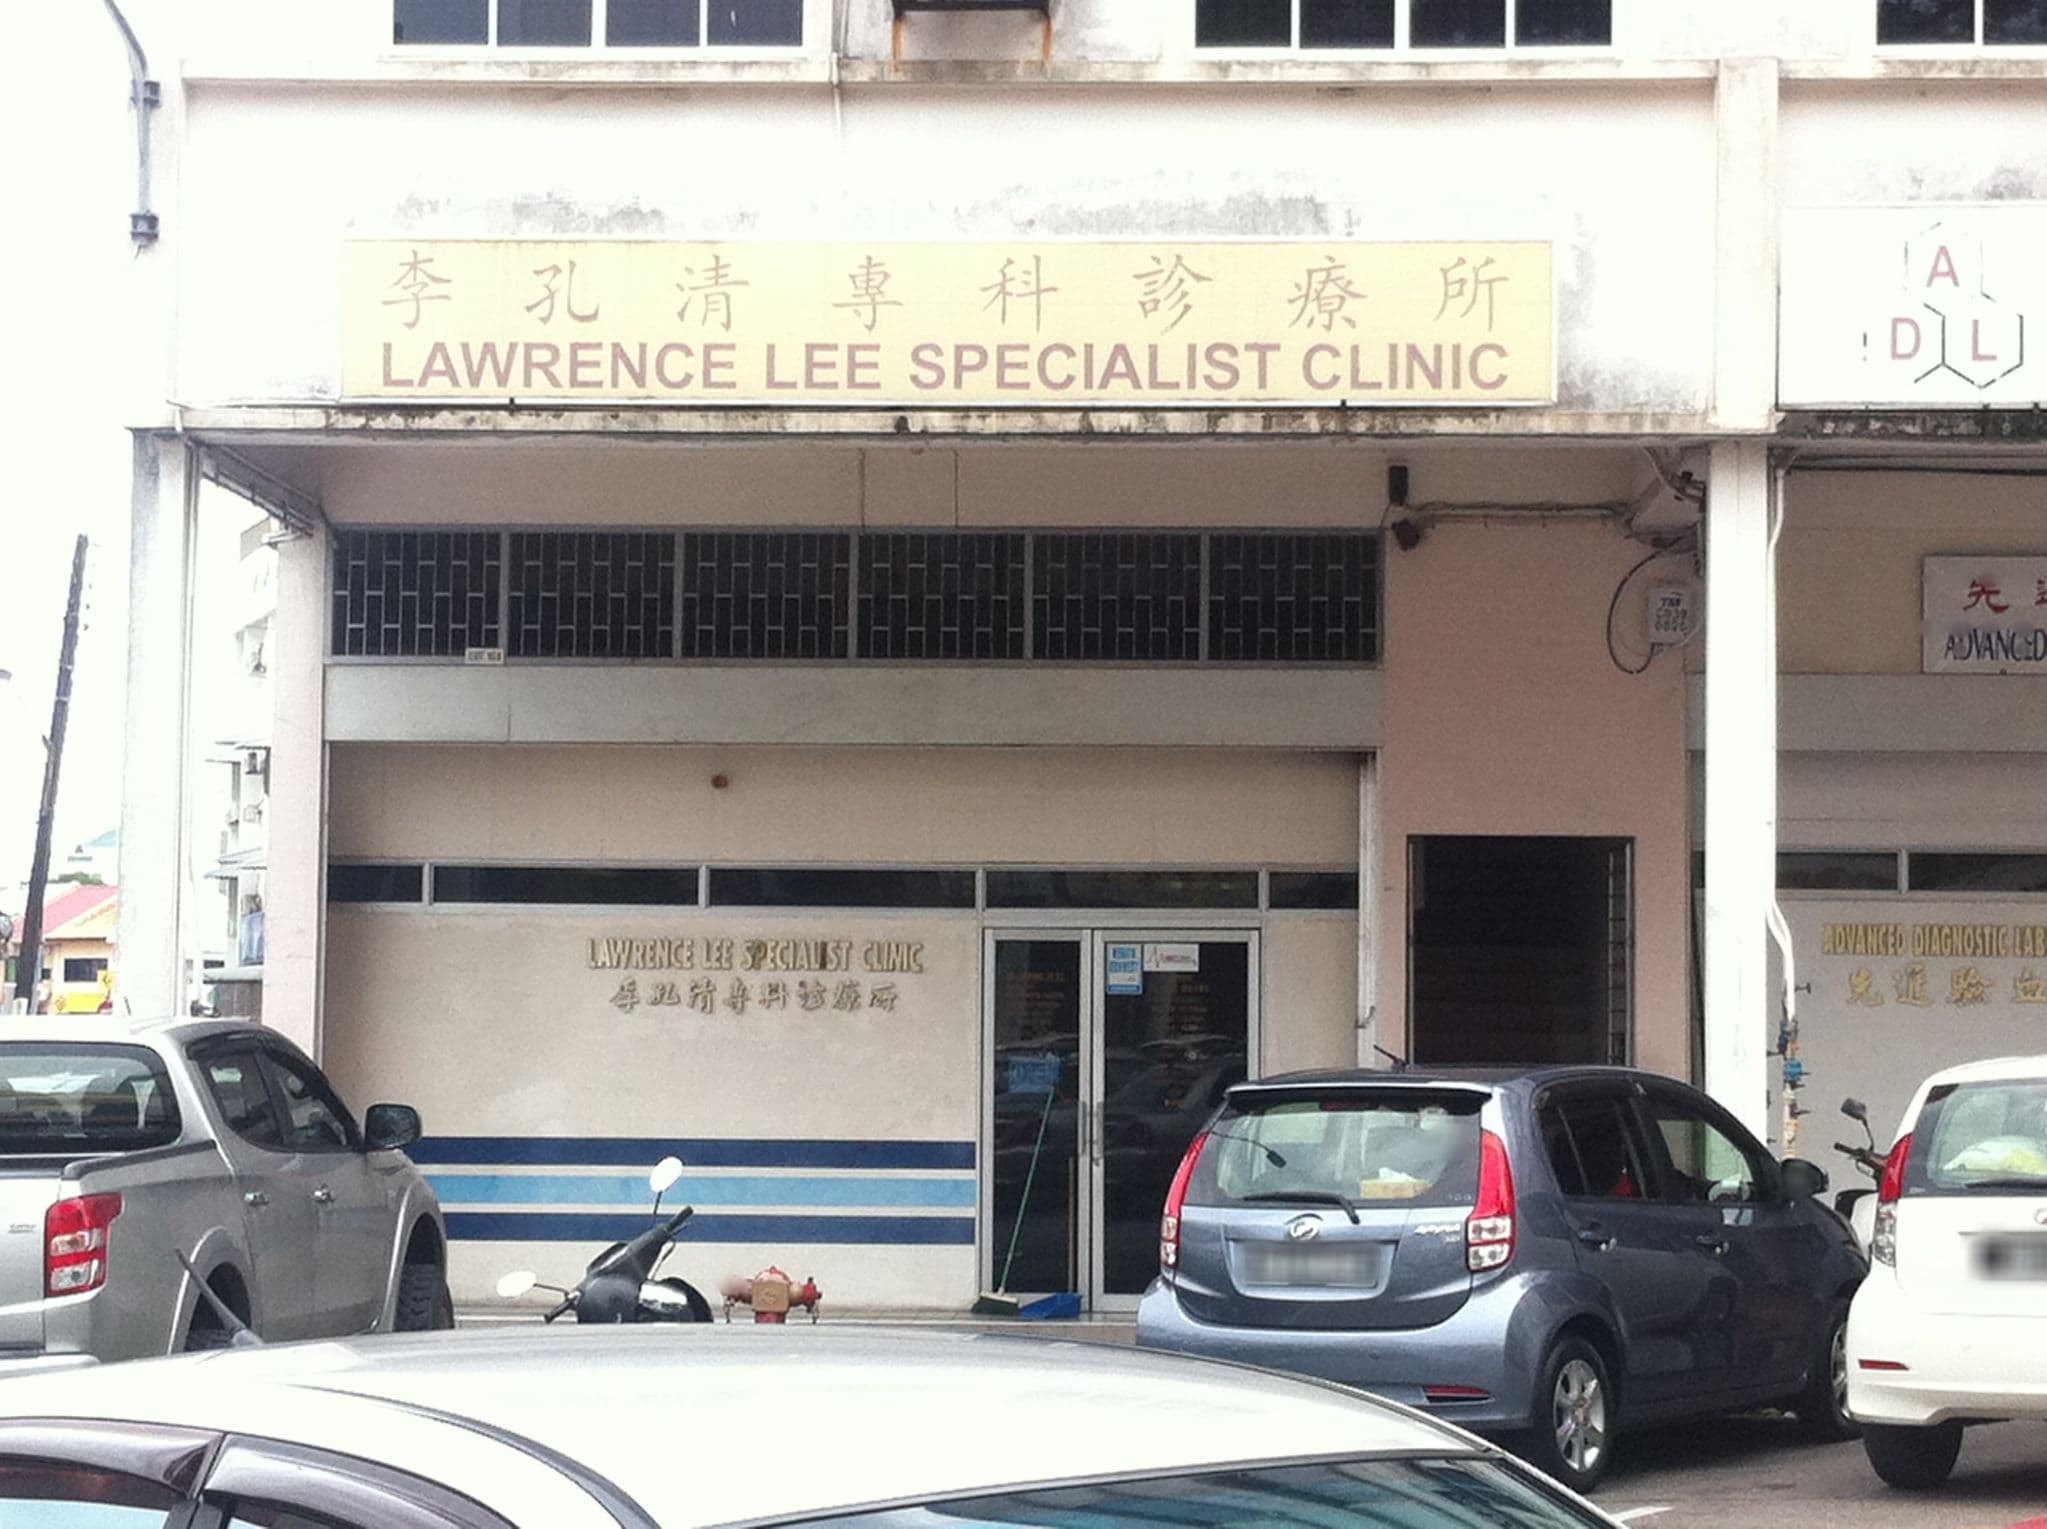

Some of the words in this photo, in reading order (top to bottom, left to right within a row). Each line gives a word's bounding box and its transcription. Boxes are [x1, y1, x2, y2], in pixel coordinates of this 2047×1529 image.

[1926, 245, 1959, 287] A
[382, 249, 1508, 333] 李孔清專科診療所
[1891, 317, 1921, 360] D
[1971, 319, 1997, 362] L
[382, 342, 736, 389] LAWRENCE
[766, 343, 881, 390] LEE
[909, 343, 1281, 391] SPECIALIST
[1302, 344, 1508, 391] CLINIC
[588, 938, 694, 970] LAWRENCE
[702, 940, 733, 971] LEE
[741, 939, 852, 972] SPECIALIST
[862, 941, 924, 974] CLINIC
[1823, 923, 1905, 955] ADVANCED
[1912, 924, 2008, 957] DIAGNOSTIC
